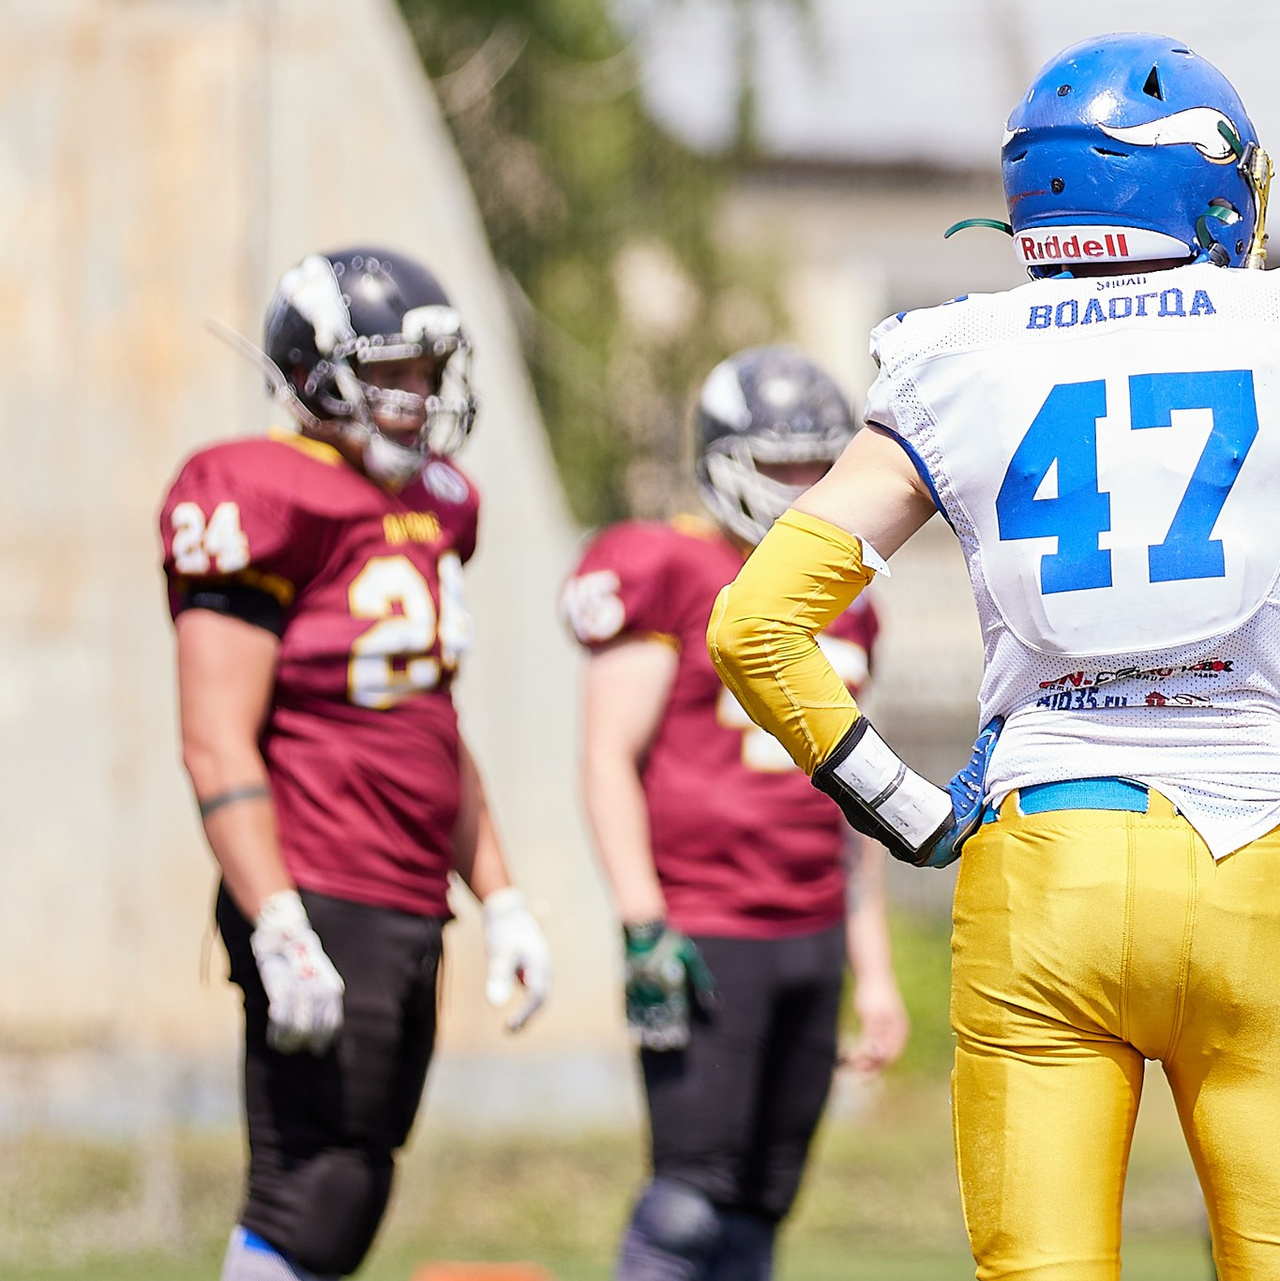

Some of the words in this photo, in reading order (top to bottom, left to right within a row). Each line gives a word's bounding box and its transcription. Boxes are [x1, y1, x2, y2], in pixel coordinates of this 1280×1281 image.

[1020, 233, 1130, 261] Riddell
[1025, 287, 1217, 330] ВОЛОГДА
[995, 369, 1260, 596] 47
[170, 501, 250, 575] 24
